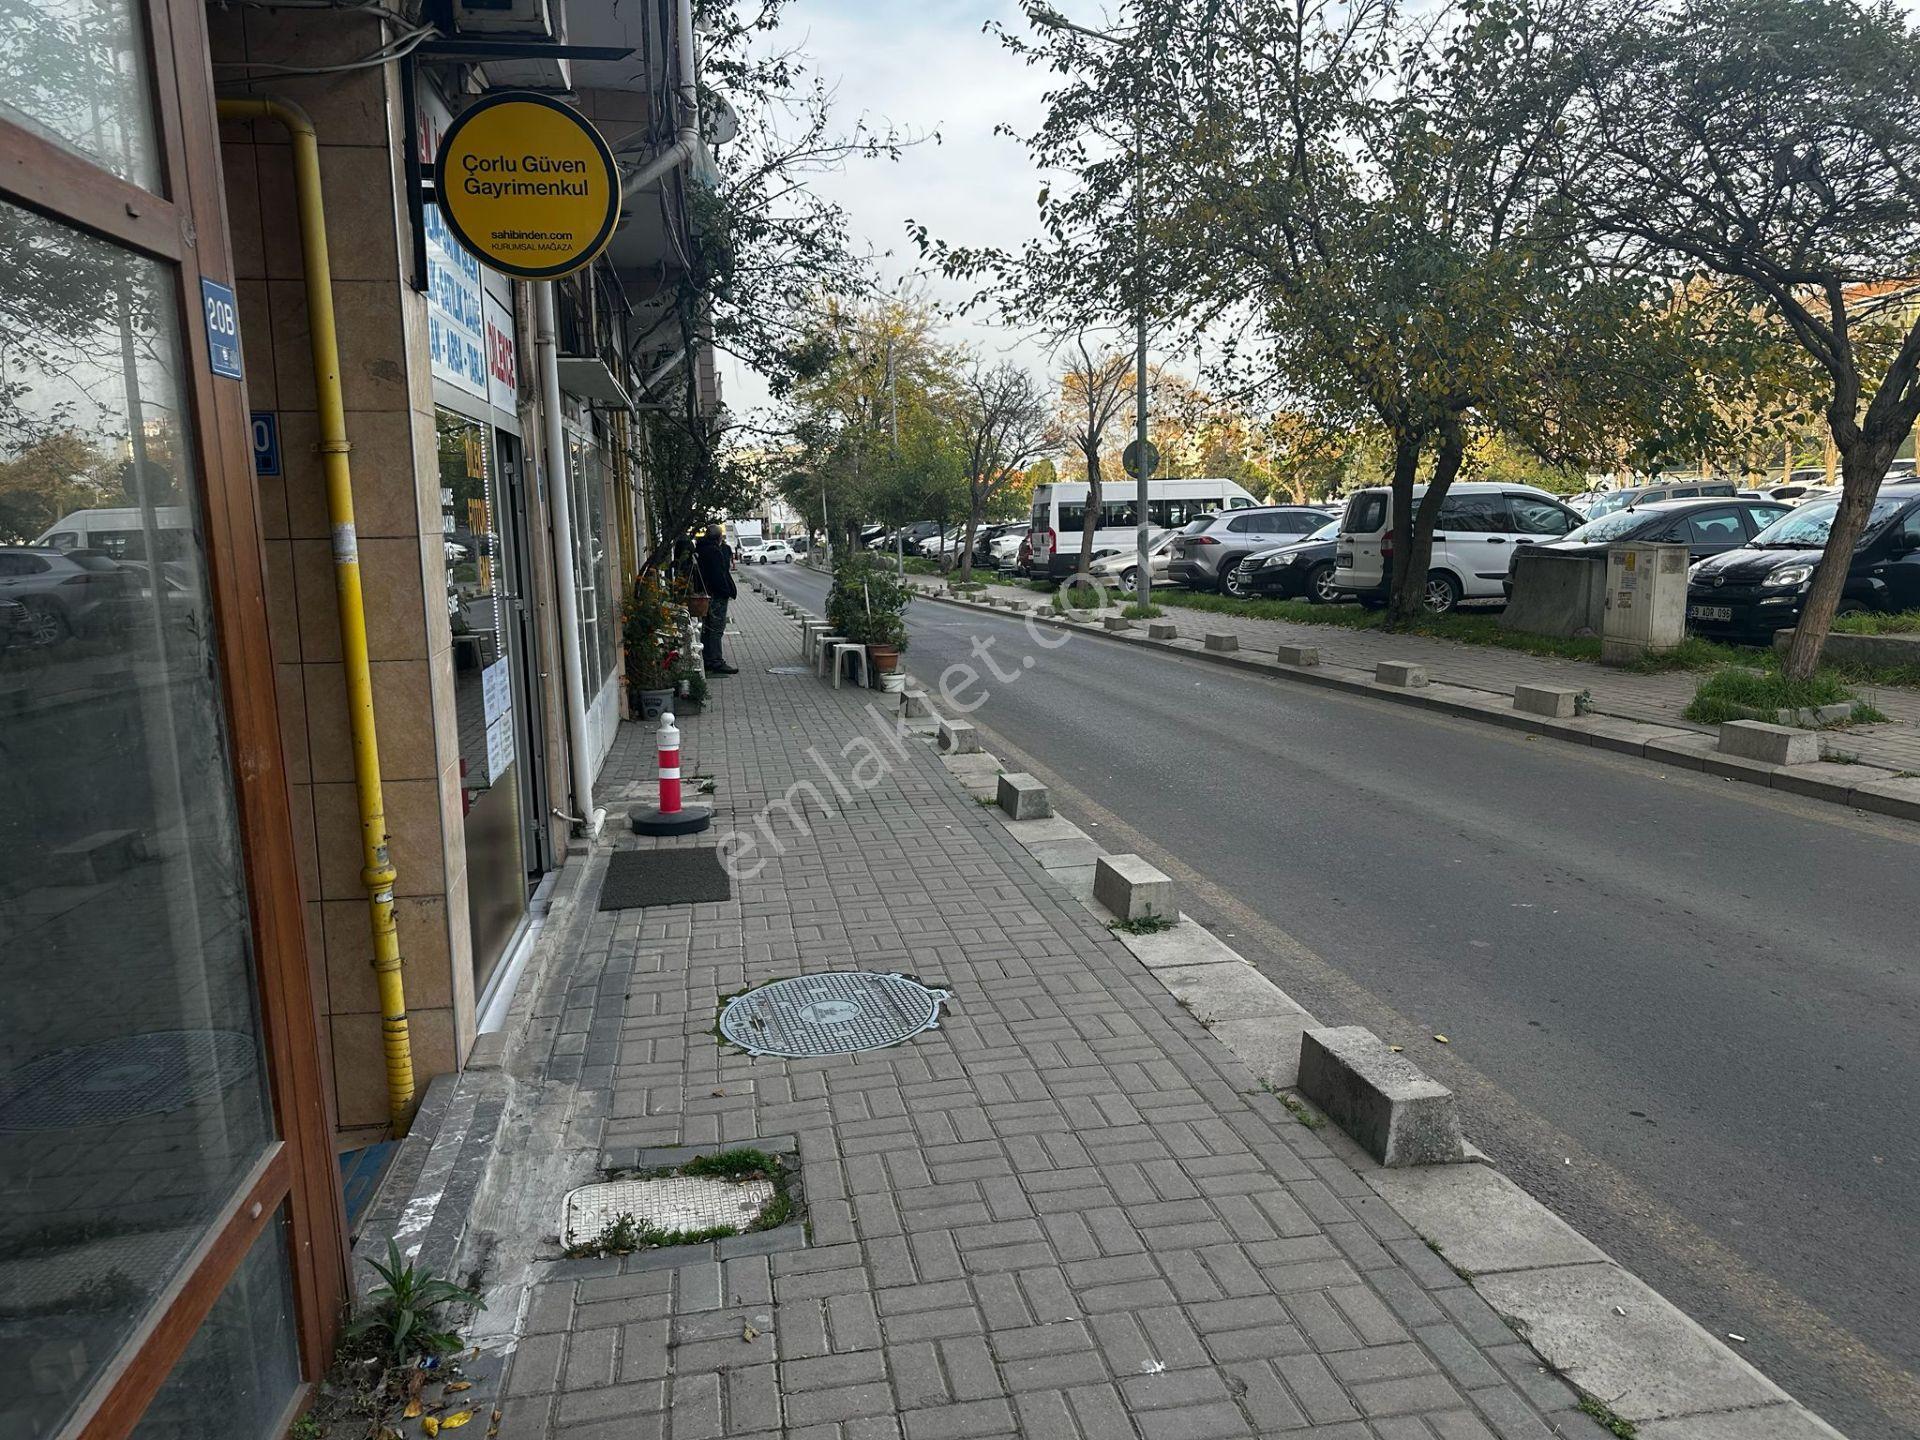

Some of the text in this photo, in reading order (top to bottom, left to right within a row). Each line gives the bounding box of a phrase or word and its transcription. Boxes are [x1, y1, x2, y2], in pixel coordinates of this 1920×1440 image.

[462, 154, 586, 175] Çorlu Güven
[464, 177, 589, 199] Gayrimenkul
[491, 230, 573, 240] sahibinden.com
[491, 243, 573, 251] KURUMSAL MAĞAZA
[208, 297, 235, 336] 20B
[488, 315, 515, 396] DİLEKÇE
[252, 420, 270, 452] 0
